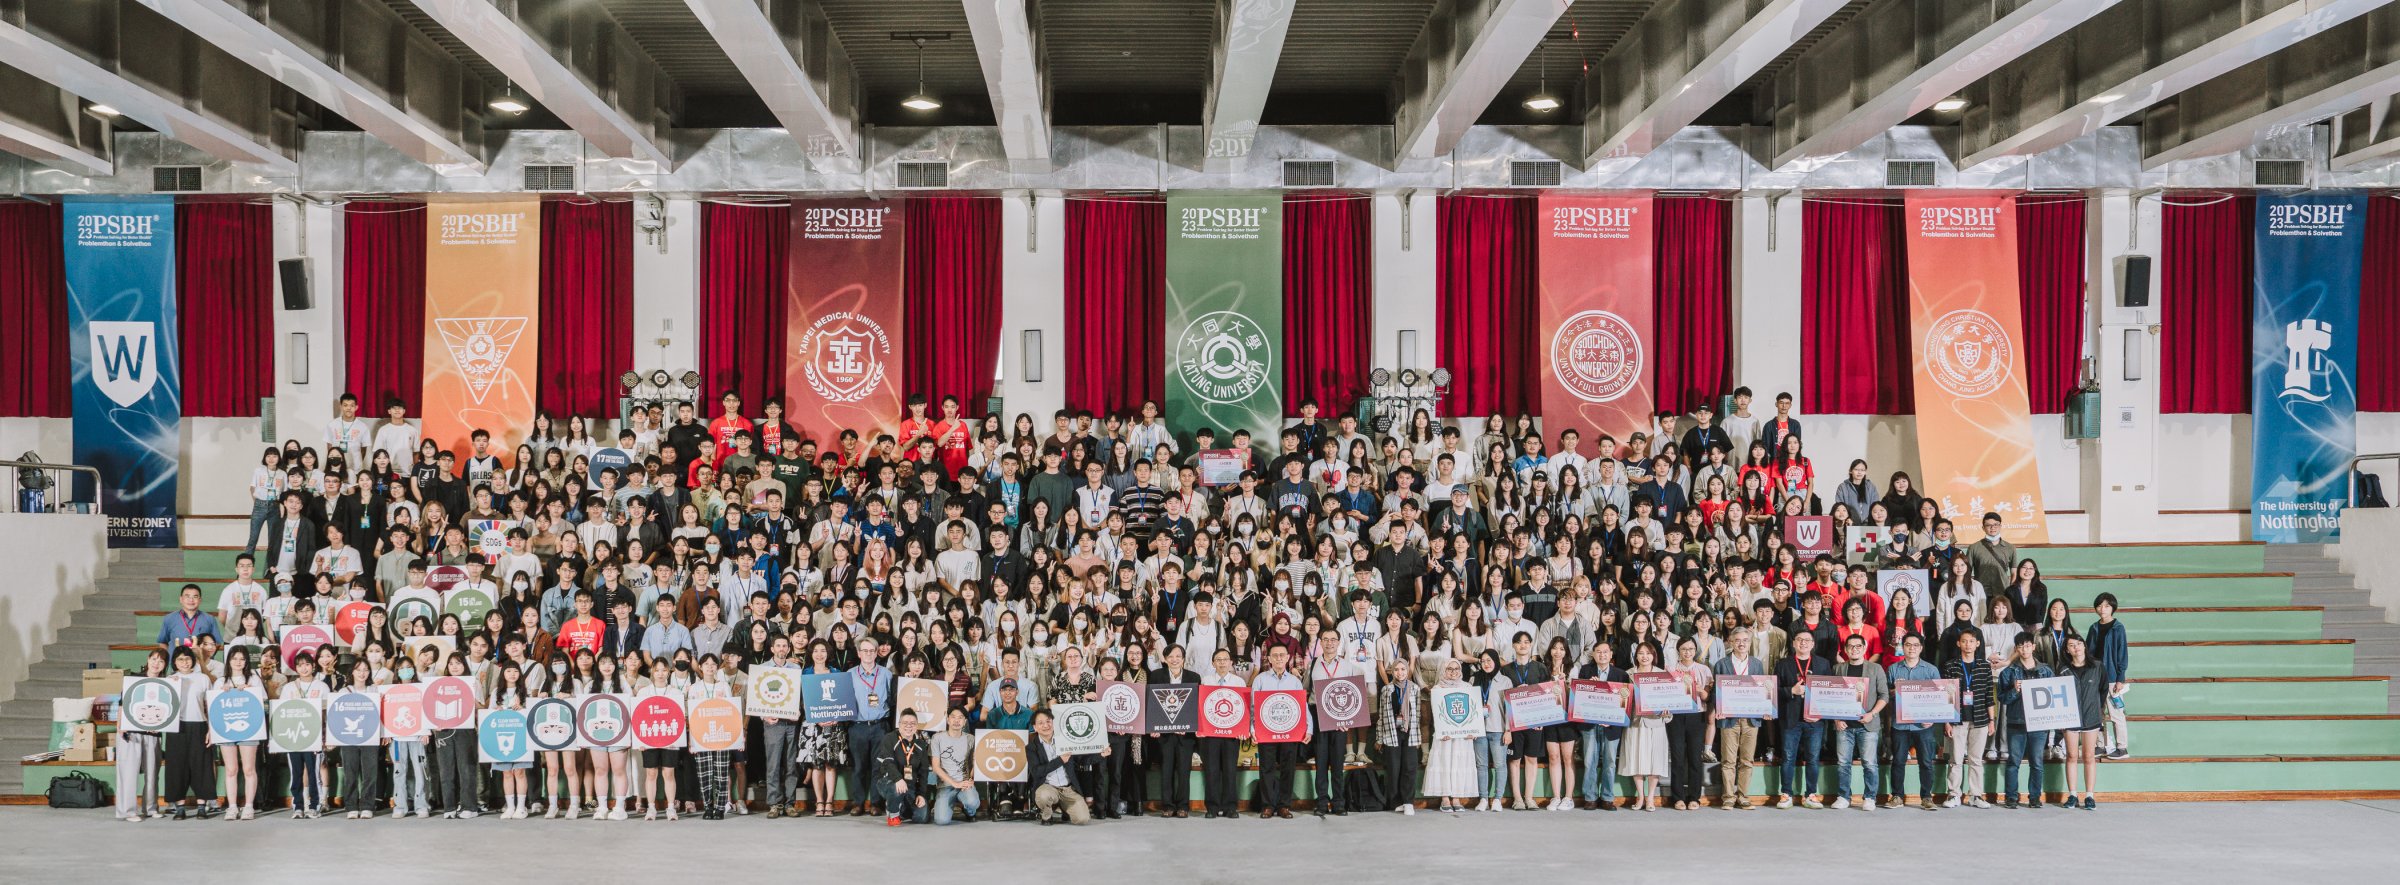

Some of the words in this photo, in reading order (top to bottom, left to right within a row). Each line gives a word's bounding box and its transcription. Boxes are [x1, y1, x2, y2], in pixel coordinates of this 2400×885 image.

[805, 208, 820, 219] 20
[1182, 208, 1196, 219] 20
[1554, 207, 1568, 218] 20
[1920, 208, 1934, 218] 20
[2269, 205, 2284, 216] 20
[78, 215, 92, 226] 20
[441, 215, 456, 226] 20
[1182, 220, 1196, 231] 23
[1554, 220, 1568, 230] 23
[1921, 220, 1935, 230] 23
[2269, 218, 2284, 229] 23
[805, 221, 819, 232] 23
[78, 228, 92, 239] 23
[441, 227, 456, 238] 23
[800, 327, 816, 354] TAIPEI
[814, 312, 854, 329] MEDICAL
[856, 314, 890, 354] UNIVERSITY
[1576, 334, 1617, 349] SOOCHOW
[97, 335, 148, 383] W
[1576, 361, 1619, 378] UNIVERSITY
[1183, 358, 1212, 393] TATUNG
[1213, 360, 1264, 398] UNIVERSITY
[1560, 358, 1574, 378] UNTO
[1578, 381, 1597, 393] FULL
[1598, 377, 1627, 394] GROWN
[597, 454, 605, 463] 17
[2260, 501, 2277, 511] The
[2278, 501, 2327, 513] University
[2328, 500, 2339, 511] of
[131, 517, 172, 528] SYDNEY
[108, 529, 153, 538] IVERSITY
[1800, 525, 1818, 540] W
[485, 537, 502, 547] SDGs
[432, 573, 438, 582] 8
[459, 597, 469, 606] 15
[351, 609, 356, 618] 5
[291, 634, 302, 643] 10
[437, 685, 443, 695] 4
[914, 687, 920, 696] 2
[220, 698, 233, 708] 14
[2031, 685, 2069, 710] DH
[335, 702, 344, 712] 16
[649, 704, 653, 714] 1
[280, 709, 286, 718] 3
[811, 710, 854, 719] Nottingham
[490, 718, 497, 728] 6
[985, 738, 996, 748] 12
